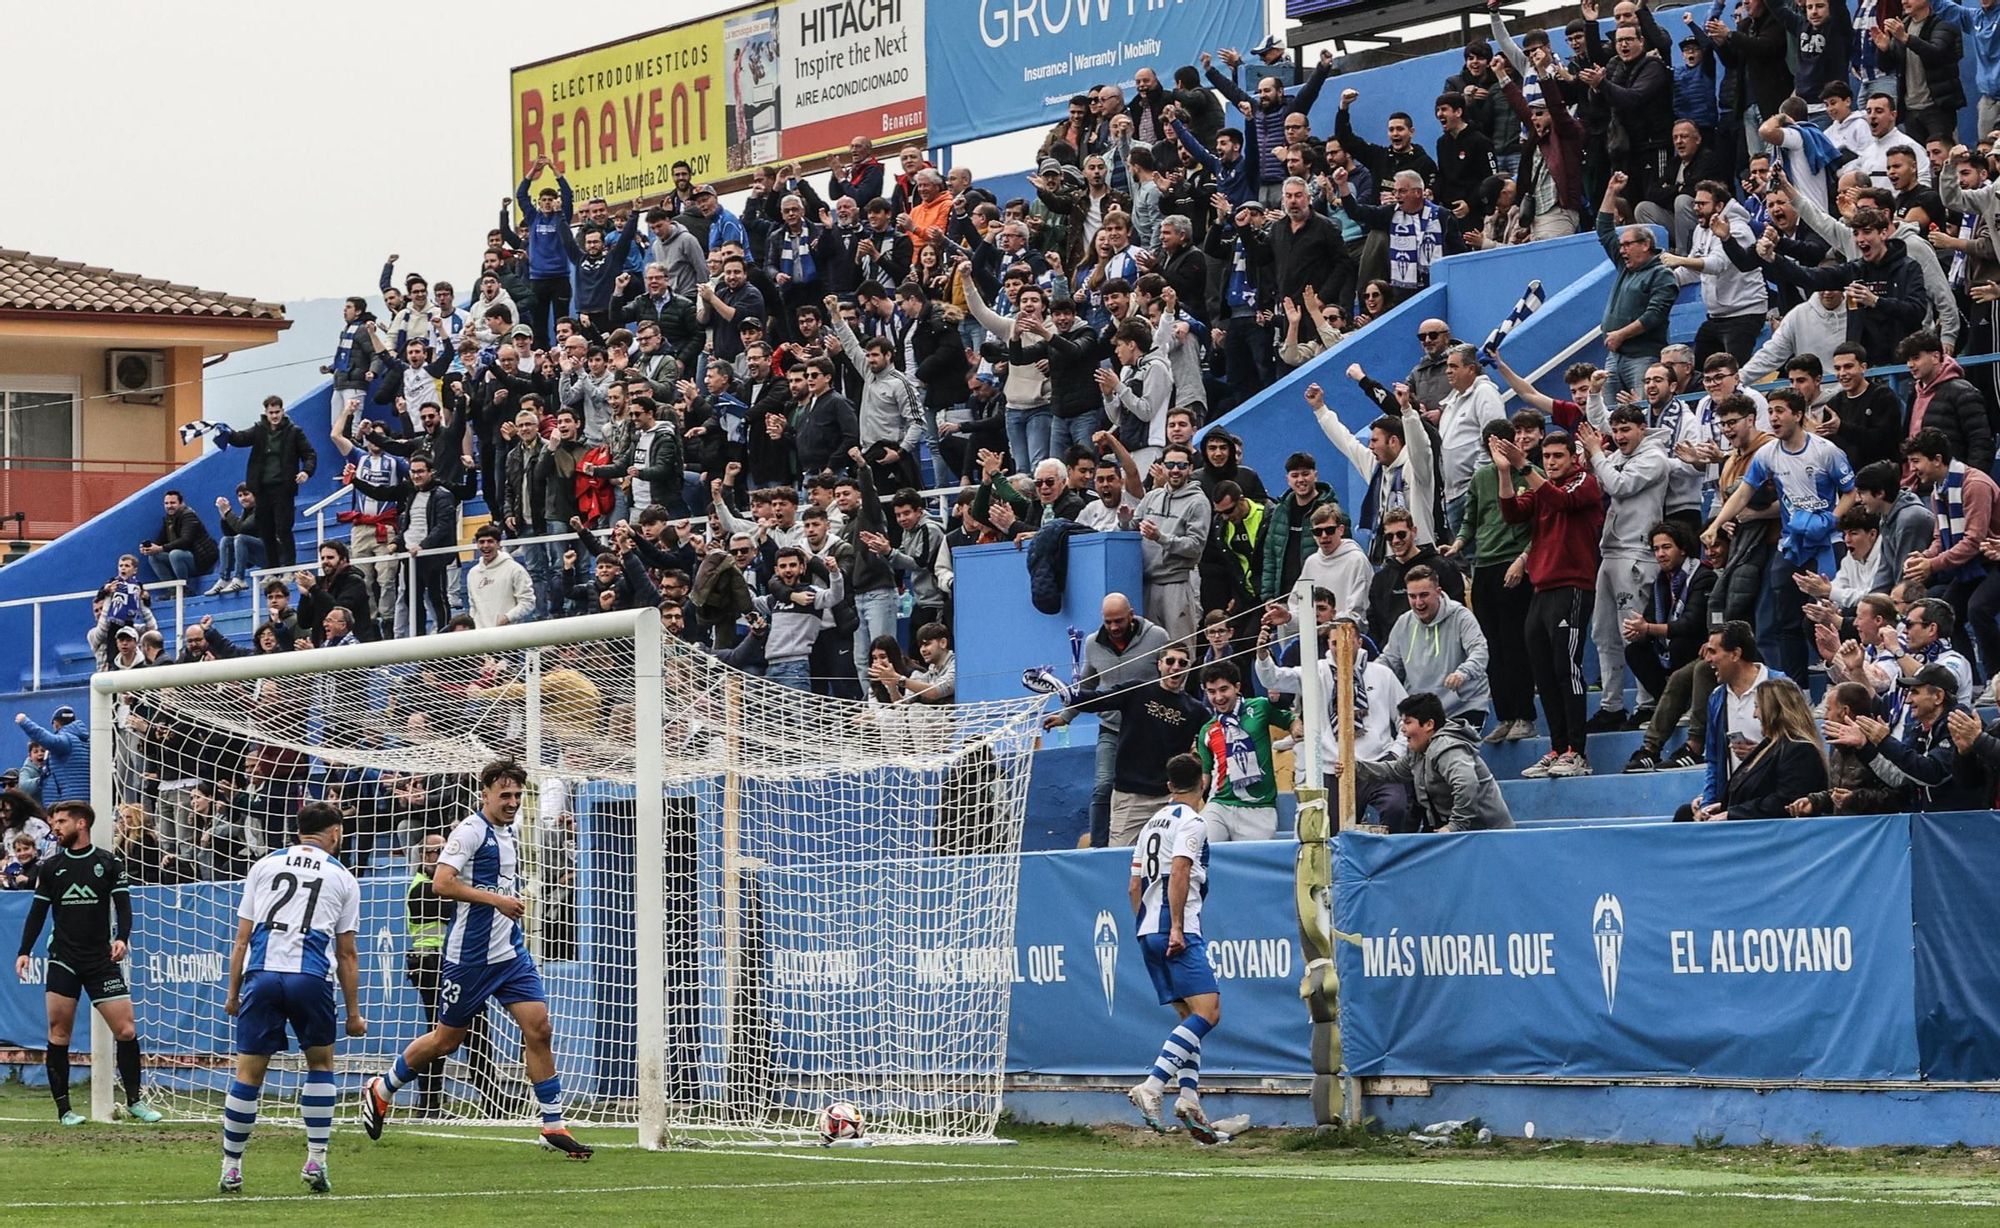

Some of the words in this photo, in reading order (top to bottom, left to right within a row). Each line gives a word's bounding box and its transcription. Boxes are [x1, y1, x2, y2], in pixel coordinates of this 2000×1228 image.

[800, 0, 902, 47] HITACHI
[552, 43, 708, 102] ELECTRODOMESTICOS
[795, 50, 844, 80] Inspire
[849, 42, 871, 66] the
[875, 30, 908, 59] Next
[1024, 61, 1068, 82] Insurance
[1074, 50, 1117, 71] Warranty
[1124, 39, 1162, 60] Mobility
[795, 89, 819, 109] AIRE
[821, 67, 909, 103] ACONDICIONADO
[882, 111, 923, 132] BENAVENT
[592, 185, 604, 199] en
[605, 177, 614, 194] la
[616, 168, 654, 194] Alameda
[657, 164, 668, 184] 20
[686, 153, 711, 177] COY
[286, 856, 321, 871] LARA
[1147, 832, 1161, 883] 8
[266, 872, 324, 935] 21
[150, 955, 165, 984] EL
[166, 953, 224, 984] ALCOYANO
[1028, 945, 1067, 985] QUE
[1207, 938, 1291, 979] COYANO
[1362, 927, 1416, 977] MÁS
[1420, 934, 1503, 976] MORAL
[1508, 932, 1556, 978] QUE
[1670, 930, 1704, 974] EL
[1711, 926, 1852, 974] ALCOYANO
[441, 979, 461, 1004] 23
